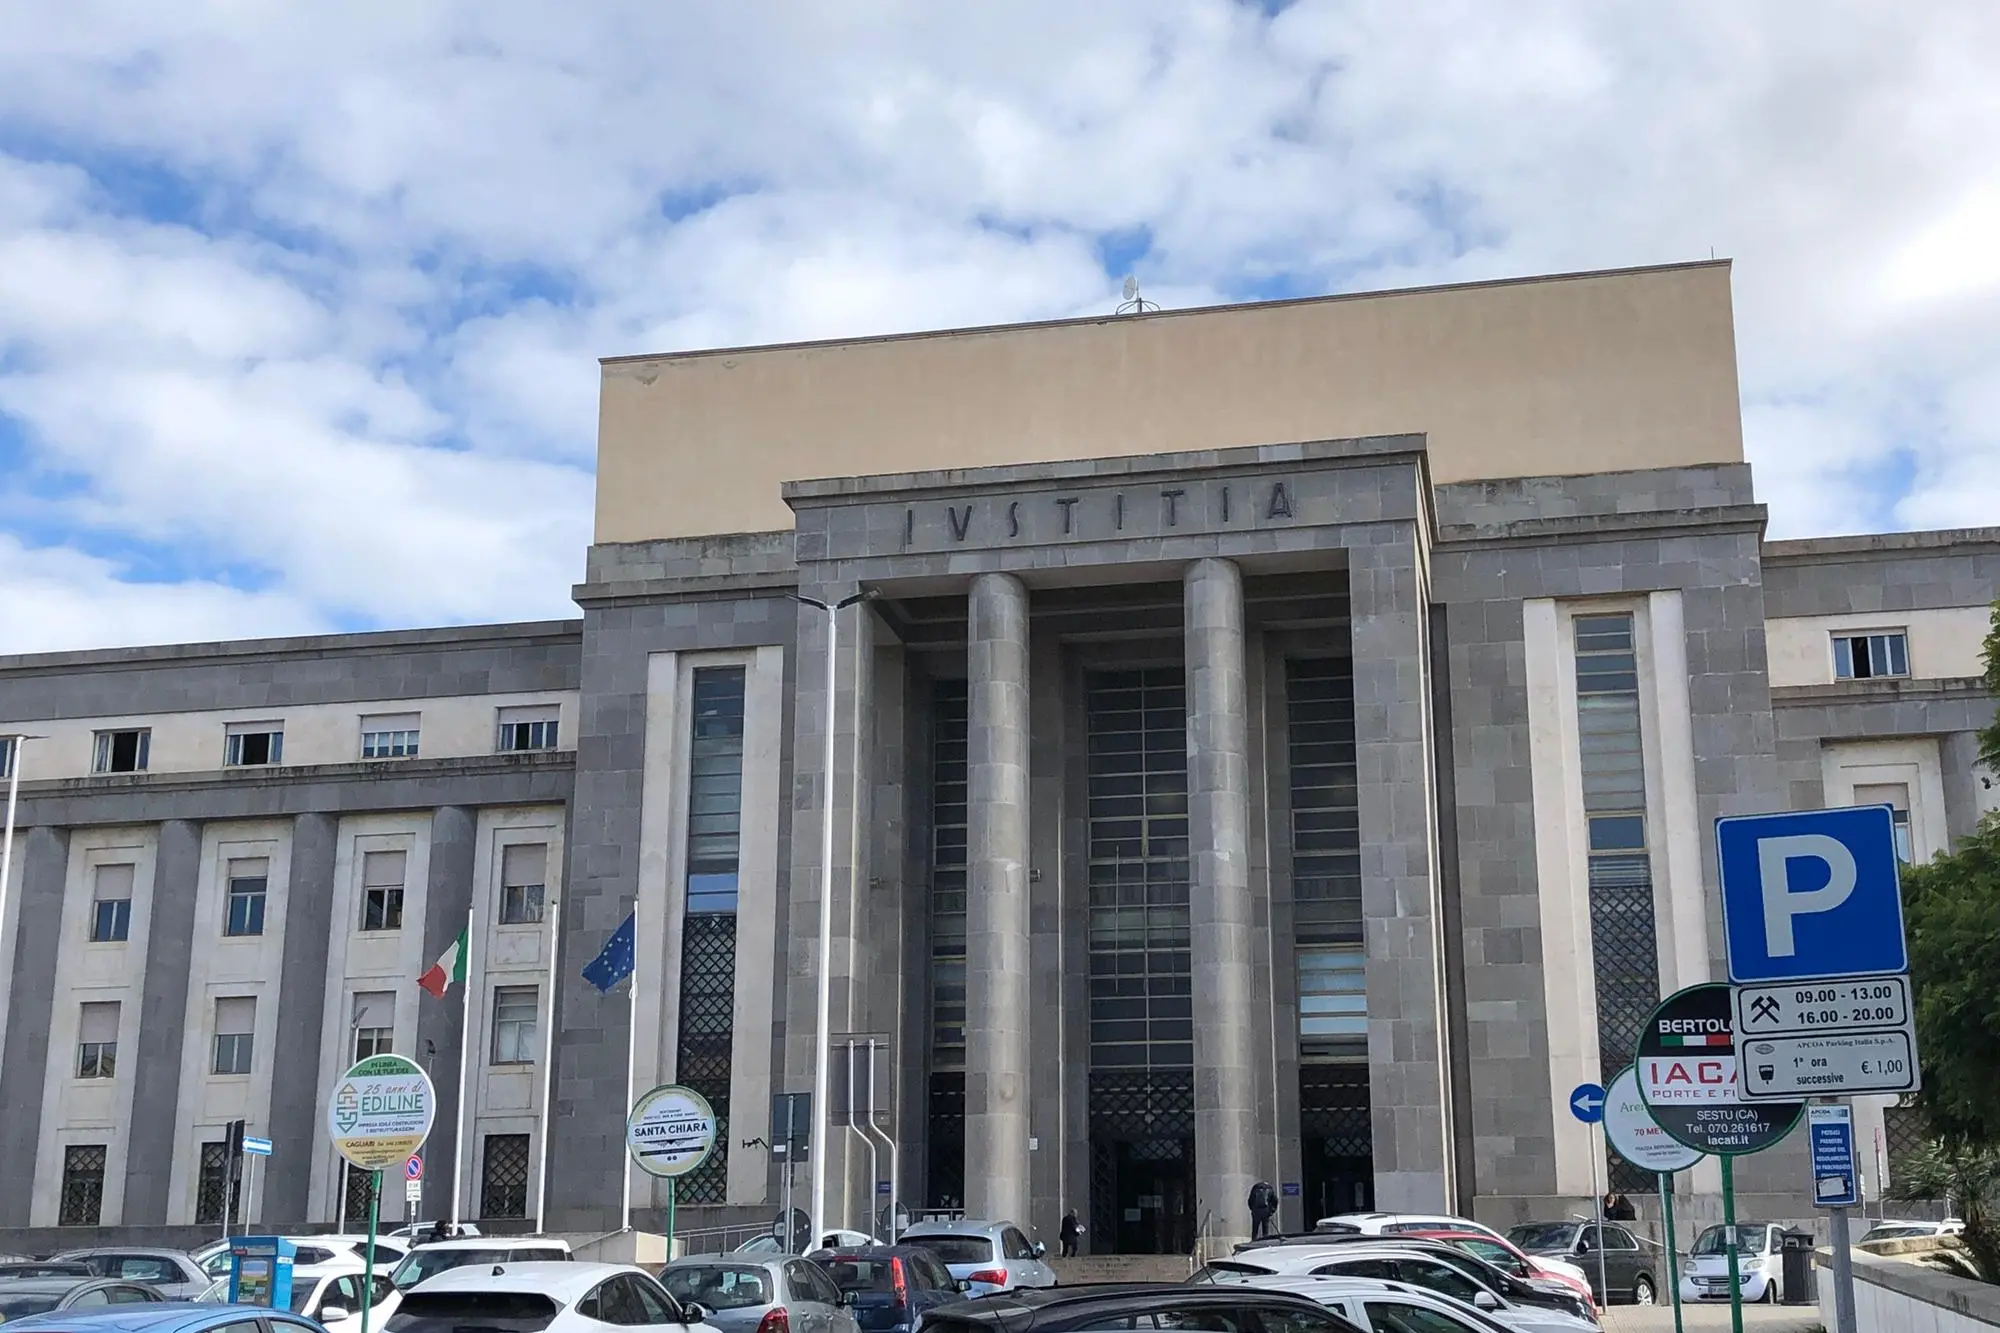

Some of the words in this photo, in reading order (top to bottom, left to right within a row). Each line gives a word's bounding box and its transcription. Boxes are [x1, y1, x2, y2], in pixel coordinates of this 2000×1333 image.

[906, 482, 1292, 544] IVSTITIA
[1757, 834, 1857, 957] P
[1795, 989, 1836, 1004] 09.00
[1851, 986, 1892, 1000] 13.00
[1797, 1010, 1838, 1024] 16.00
[1852, 1007, 1894, 1021] 20.00
[1658, 1019, 1733, 1033] BERTOL
[1826, 1040, 1853, 1048] Parking
[1874, 1038, 1896, 1046] S.p.A.
[1811, 1058, 1828, 1067] ora
[1877, 1059, 1903, 1076] 1,00
[1796, 1072, 1844, 1085] successive
[363, 1084, 381, 1095] 25
[1652, 1089, 1701, 1099] PORTE
[1708, 1089, 1717, 1098] E
[362, 1094, 424, 1112] EDILINE
[1696, 1110, 1733, 1121] SESTU
[1735, 1109, 1759, 1122] (CA)
[634, 1126, 666, 1137] SANTA
[668, 1122, 708, 1133] CHIARA
[1634, 1128, 1645, 1137] 70
[1686, 1123, 1706, 1134] Tel.
[1707, 1135, 1749, 1145] iacati.it
